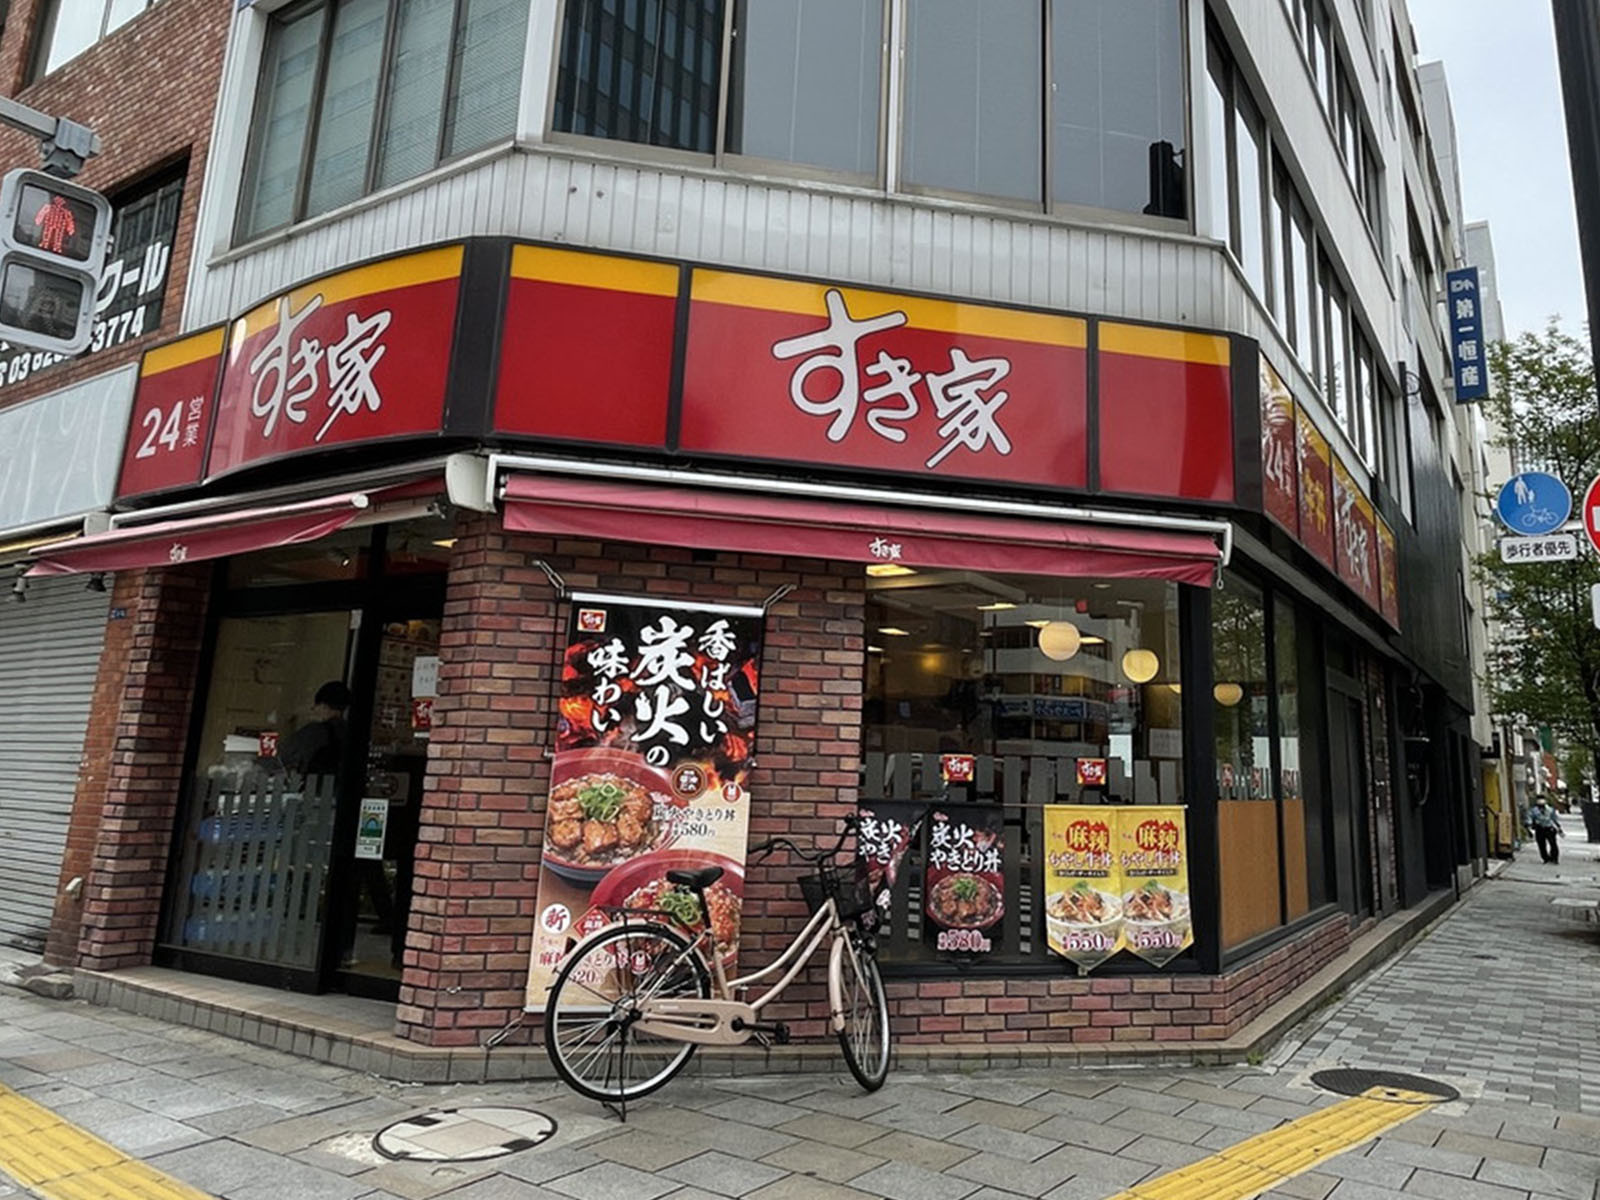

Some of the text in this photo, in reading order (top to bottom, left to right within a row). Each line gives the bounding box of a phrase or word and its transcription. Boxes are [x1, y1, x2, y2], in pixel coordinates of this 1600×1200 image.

[92, 305, 146, 352] 3774
[1456, 298, 1479, 387] 第一恒産
[250, 294, 392, 442] すき家
[772, 290, 1011, 468] すき家
[135, 401, 183, 459] 24
[1506, 541, 1571, 559] 歩行者優先
[586, 637, 630, 733] 味わい
[629, 615, 697, 767] 炭火の
[698, 619, 737, 743] 香ばしい
[859, 818, 902, 842] 炭火
[930, 822, 974, 849] 炭火
[546, 908, 567, 930] 新
